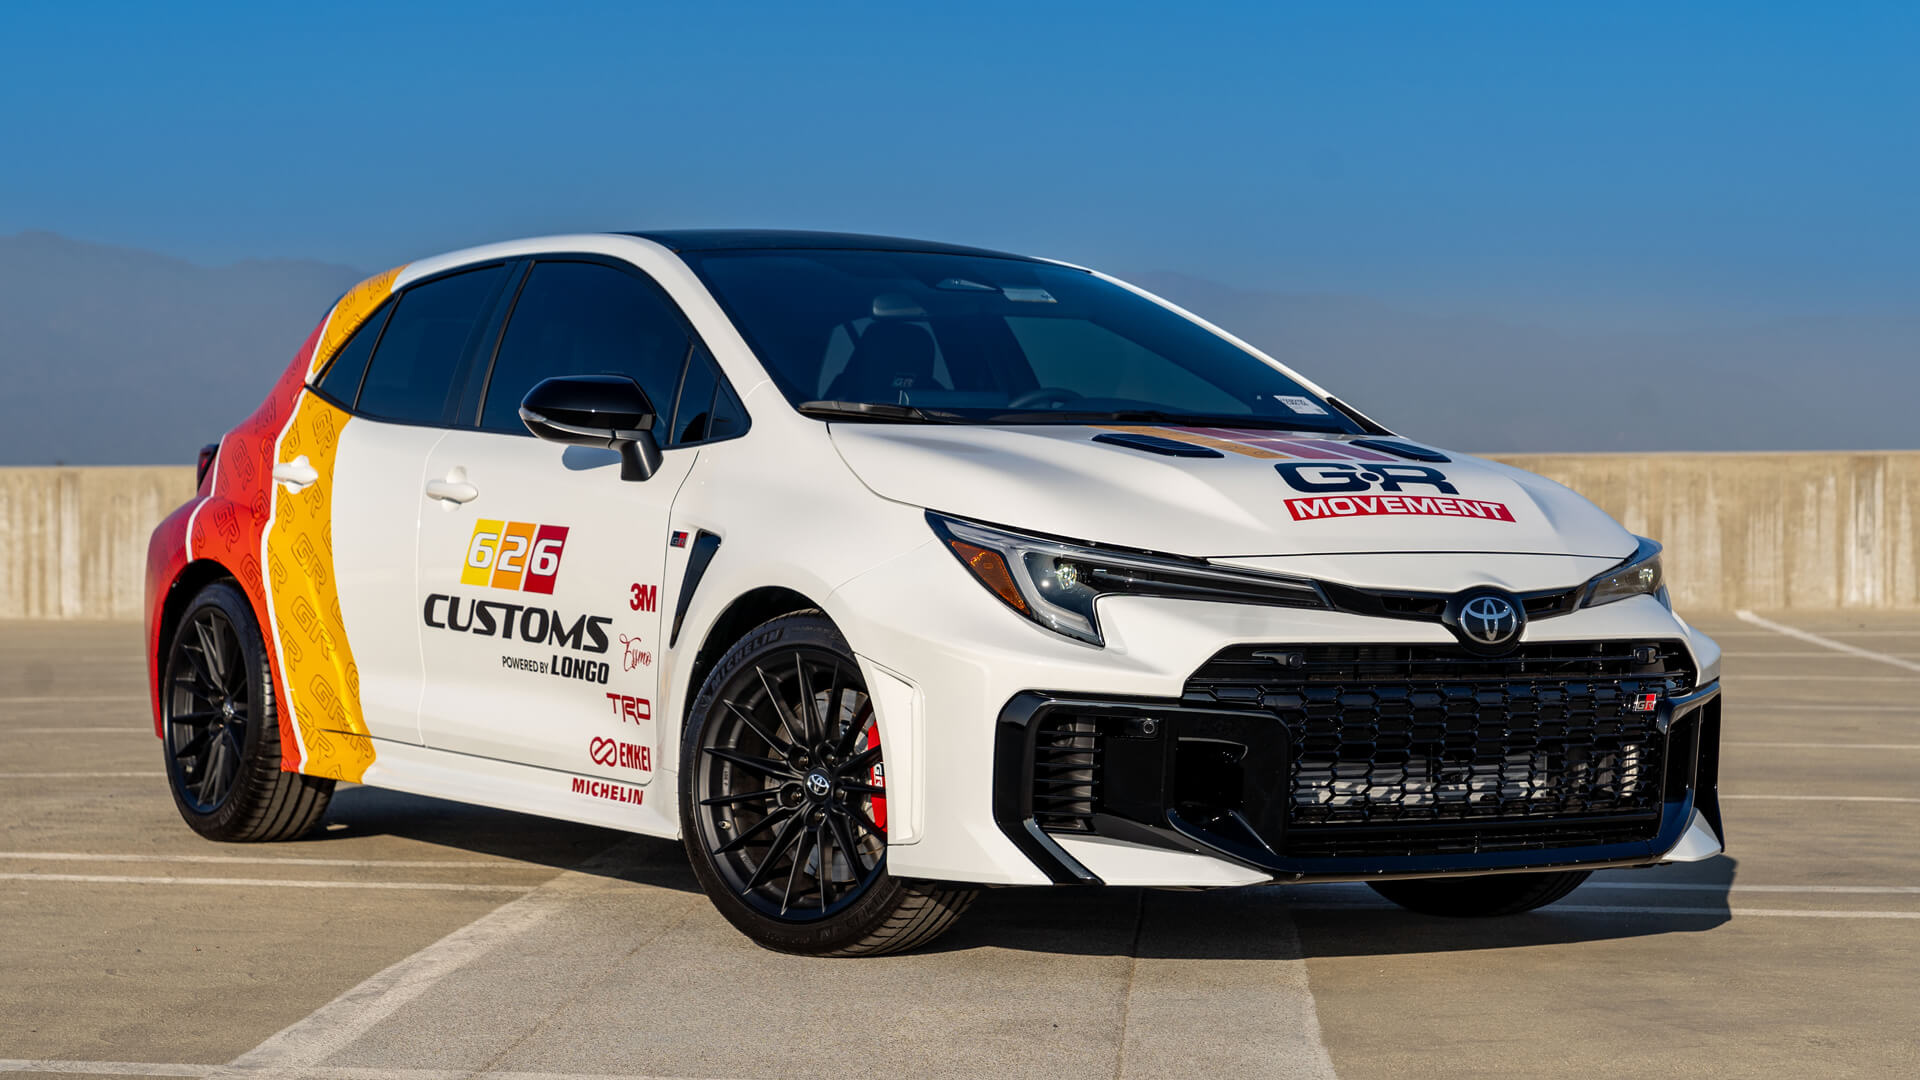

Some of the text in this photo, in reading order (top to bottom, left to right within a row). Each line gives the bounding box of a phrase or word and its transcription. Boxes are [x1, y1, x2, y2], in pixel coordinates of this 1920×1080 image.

[1296, 495, 1502, 519] MOVEMENT
[291, 531, 327, 595] GR
[467, 532, 563, 577] 626
[629, 583, 657, 612] 3M
[291, 594, 336, 661] GR
[424, 593, 613, 654] CUSTOMS
[502, 654, 610, 685] POWERED BY LONGO
[606, 692, 651, 725] TRD
[619, 742, 652, 773] ENKEI
[572, 777, 644, 806] MICHELIN
